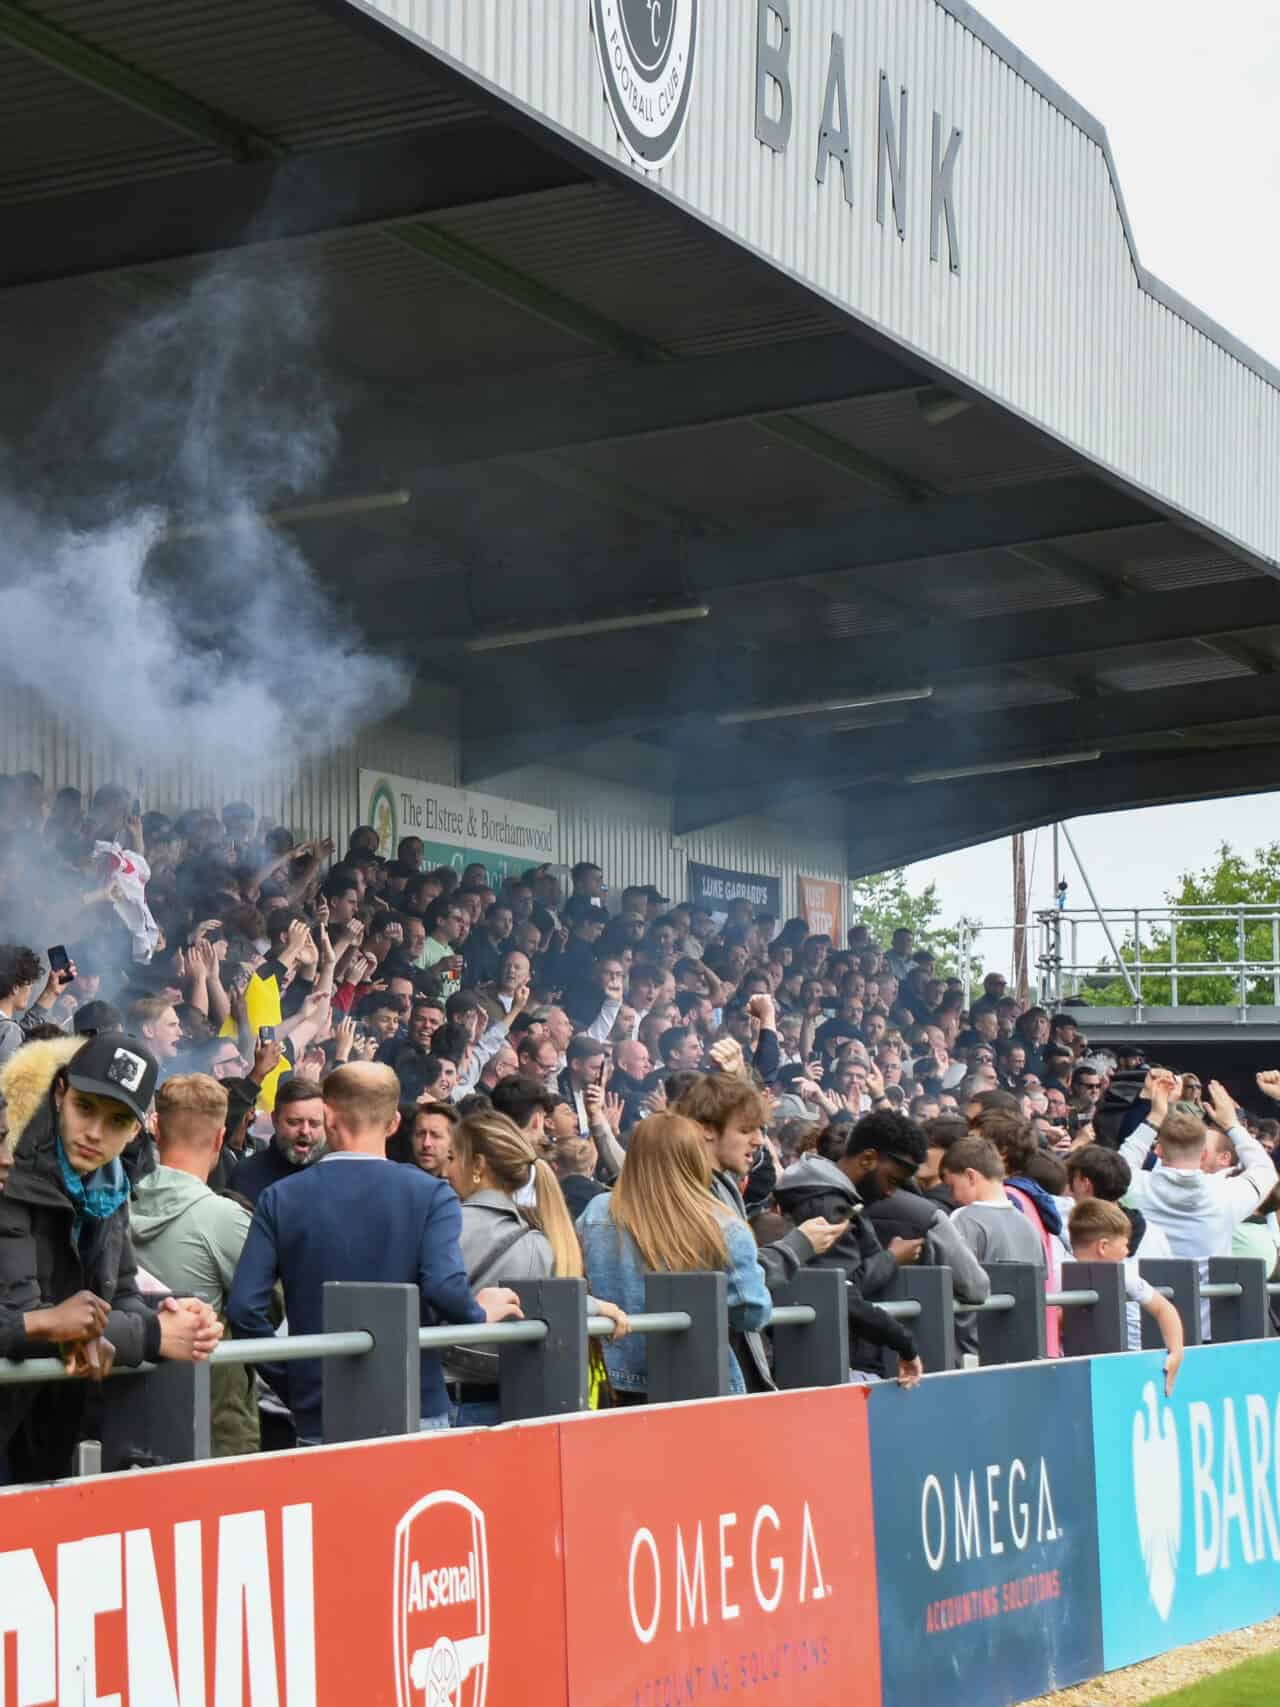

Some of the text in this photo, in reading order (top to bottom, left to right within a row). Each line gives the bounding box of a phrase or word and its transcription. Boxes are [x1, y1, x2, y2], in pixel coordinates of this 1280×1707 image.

[610, 29, 679, 122] FOOTBALL CLUB
[755, 0, 961, 276] BANK
[400, 793, 553, 852] The Elstree & Borehamwood
[702, 876, 724, 899] LUKE
[921, 1456, 1057, 1570] OMEGA
[1188, 1390, 1280, 1576] BAR
[408, 1551, 476, 1613] Arsenal
[628, 1501, 825, 1643] OMEGA
[926, 1569, 1061, 1633] ACCOUNTING SOLUTIONS
[739, 1635, 829, 1689] SOLUTIONS
